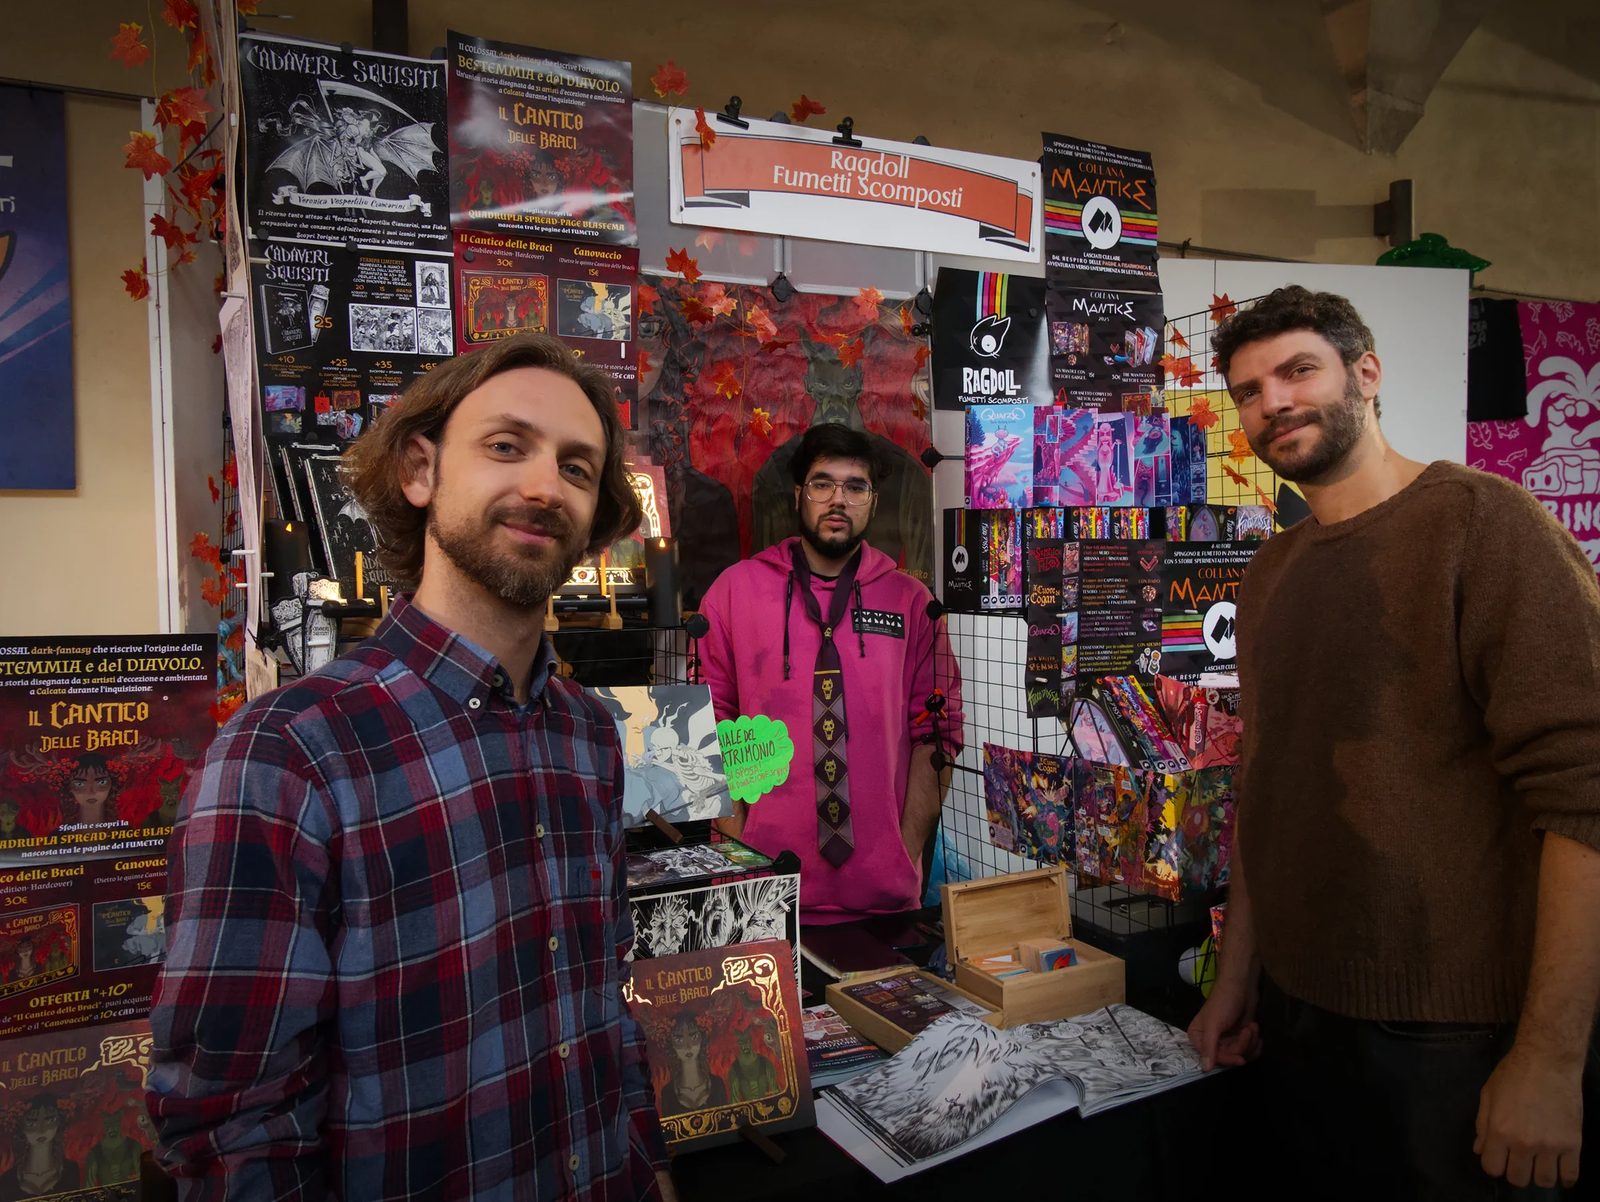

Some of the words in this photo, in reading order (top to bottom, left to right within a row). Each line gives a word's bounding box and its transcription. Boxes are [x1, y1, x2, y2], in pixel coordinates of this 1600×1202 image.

[464, 44, 497, 58] COLOSSAL
[246, 45, 344, 80] CADAVERI
[353, 60, 438, 89] SQUISITI
[458, 54, 535, 81] BESTEMMIA
[537, 73, 544, 82] e
[567, 75, 623, 94] DIAVOLO.
[499, 78, 526, 89] disegnata
[513, 102, 584, 131] CANTICO
[508, 129, 535, 145] DELLE
[539, 131, 577, 150] BRACI
[831, 150, 910, 179] Ragdoll
[1079, 162, 1125, 179] COLLANA
[773, 165, 851, 193] Fumetti
[857, 175, 964, 209] Scomposti
[468, 210, 523, 222] QUADRUPLA
[525, 215, 581, 227] SPREAD-PAGE
[583, 221, 625, 231] BLASFEMA
[460, 234, 467, 242] Il
[470, 235, 504, 246] Cantico
[505, 239, 528, 249] delle
[529, 242, 553, 252] Braci
[264, 243, 334, 266] CADAVERI
[497, 259, 513, 267] 30€
[574, 248, 622, 260] Canovaccio
[265, 263, 330, 282] SQUISITI
[1090, 291, 1120, 301] COLLANA
[314, 315, 334, 329] 25
[330, 358, 348, 367] +25
[375, 361, 393, 369] +35
[963, 367, 1021, 395] RAGDOLL
[1030, 592, 1056, 607] Cogan
[1169, 577, 1240, 609] MANT
[30, 646, 91, 656] dark-fantasy
[92, 645, 108, 654] che
[109, 644, 142, 653] riscrive
[143, 644, 180, 654] l'origine
[181, 643, 203, 652] della
[0, 659, 82, 676] STEMMIA
[85, 662, 93, 673] e
[98, 659, 122, 673] del
[126, 657, 205, 672] DIAVOLO.
[5, 678, 29, 686] storia
[30, 677, 70, 688] disegnata
[91, 676, 116, 684] artisti
[117, 675, 158, 684] d'eccezione
[165, 674, 208, 682] ambientata
[36, 687, 67, 695] Calcata
[67, 686, 99, 694] durante
[100, 685, 153, 695] l'inquisizione:
[28, 710, 43, 727] IL
[49, 700, 149, 729] CANTICO
[40, 735, 81, 753] DELLE
[86, 729, 139, 751] BRACI
[718, 729, 742, 748] AIALE
[744, 728, 756, 742] DEL
[721, 740, 775, 767] ATRIMONIO
[58, 823, 88, 832] Sfoglia
[95, 821, 120, 831] scopri
[0, 836, 58, 849] ADRUPLA
[60, 829, 140, 845] SPREAD-PAGE
[142, 826, 175, 837] BLAS
[21, 849, 58, 859] nascosta
[59, 847, 72, 855] tra
[82, 844, 111, 854] pagine
[125, 838, 164, 849] FUMETTO
[16, 870, 49, 883] delle
[51, 865, 85, 879] Braci
[114, 858, 168, 872] Canovac
[31, 880, 73, 891] Hardcover)
[137, 882, 152, 890] 15€
[5, 896, 28, 906] 30€
[657, 966, 713, 990] CANTICO
[29, 989, 90, 1009] OFFERTA
[655, 994, 677, 1007] DELLE
[679, 985, 709, 1004] BRACI
[24, 1010, 55, 1019] Cantico
[56, 1007, 77, 1015] delle
[118, 1007, 135, 1016] CAD
[17, 1046, 87, 1073] CANTICO
[9, 1076, 39, 1091] DELLE
[41, 1067, 79, 1087] BRACI
